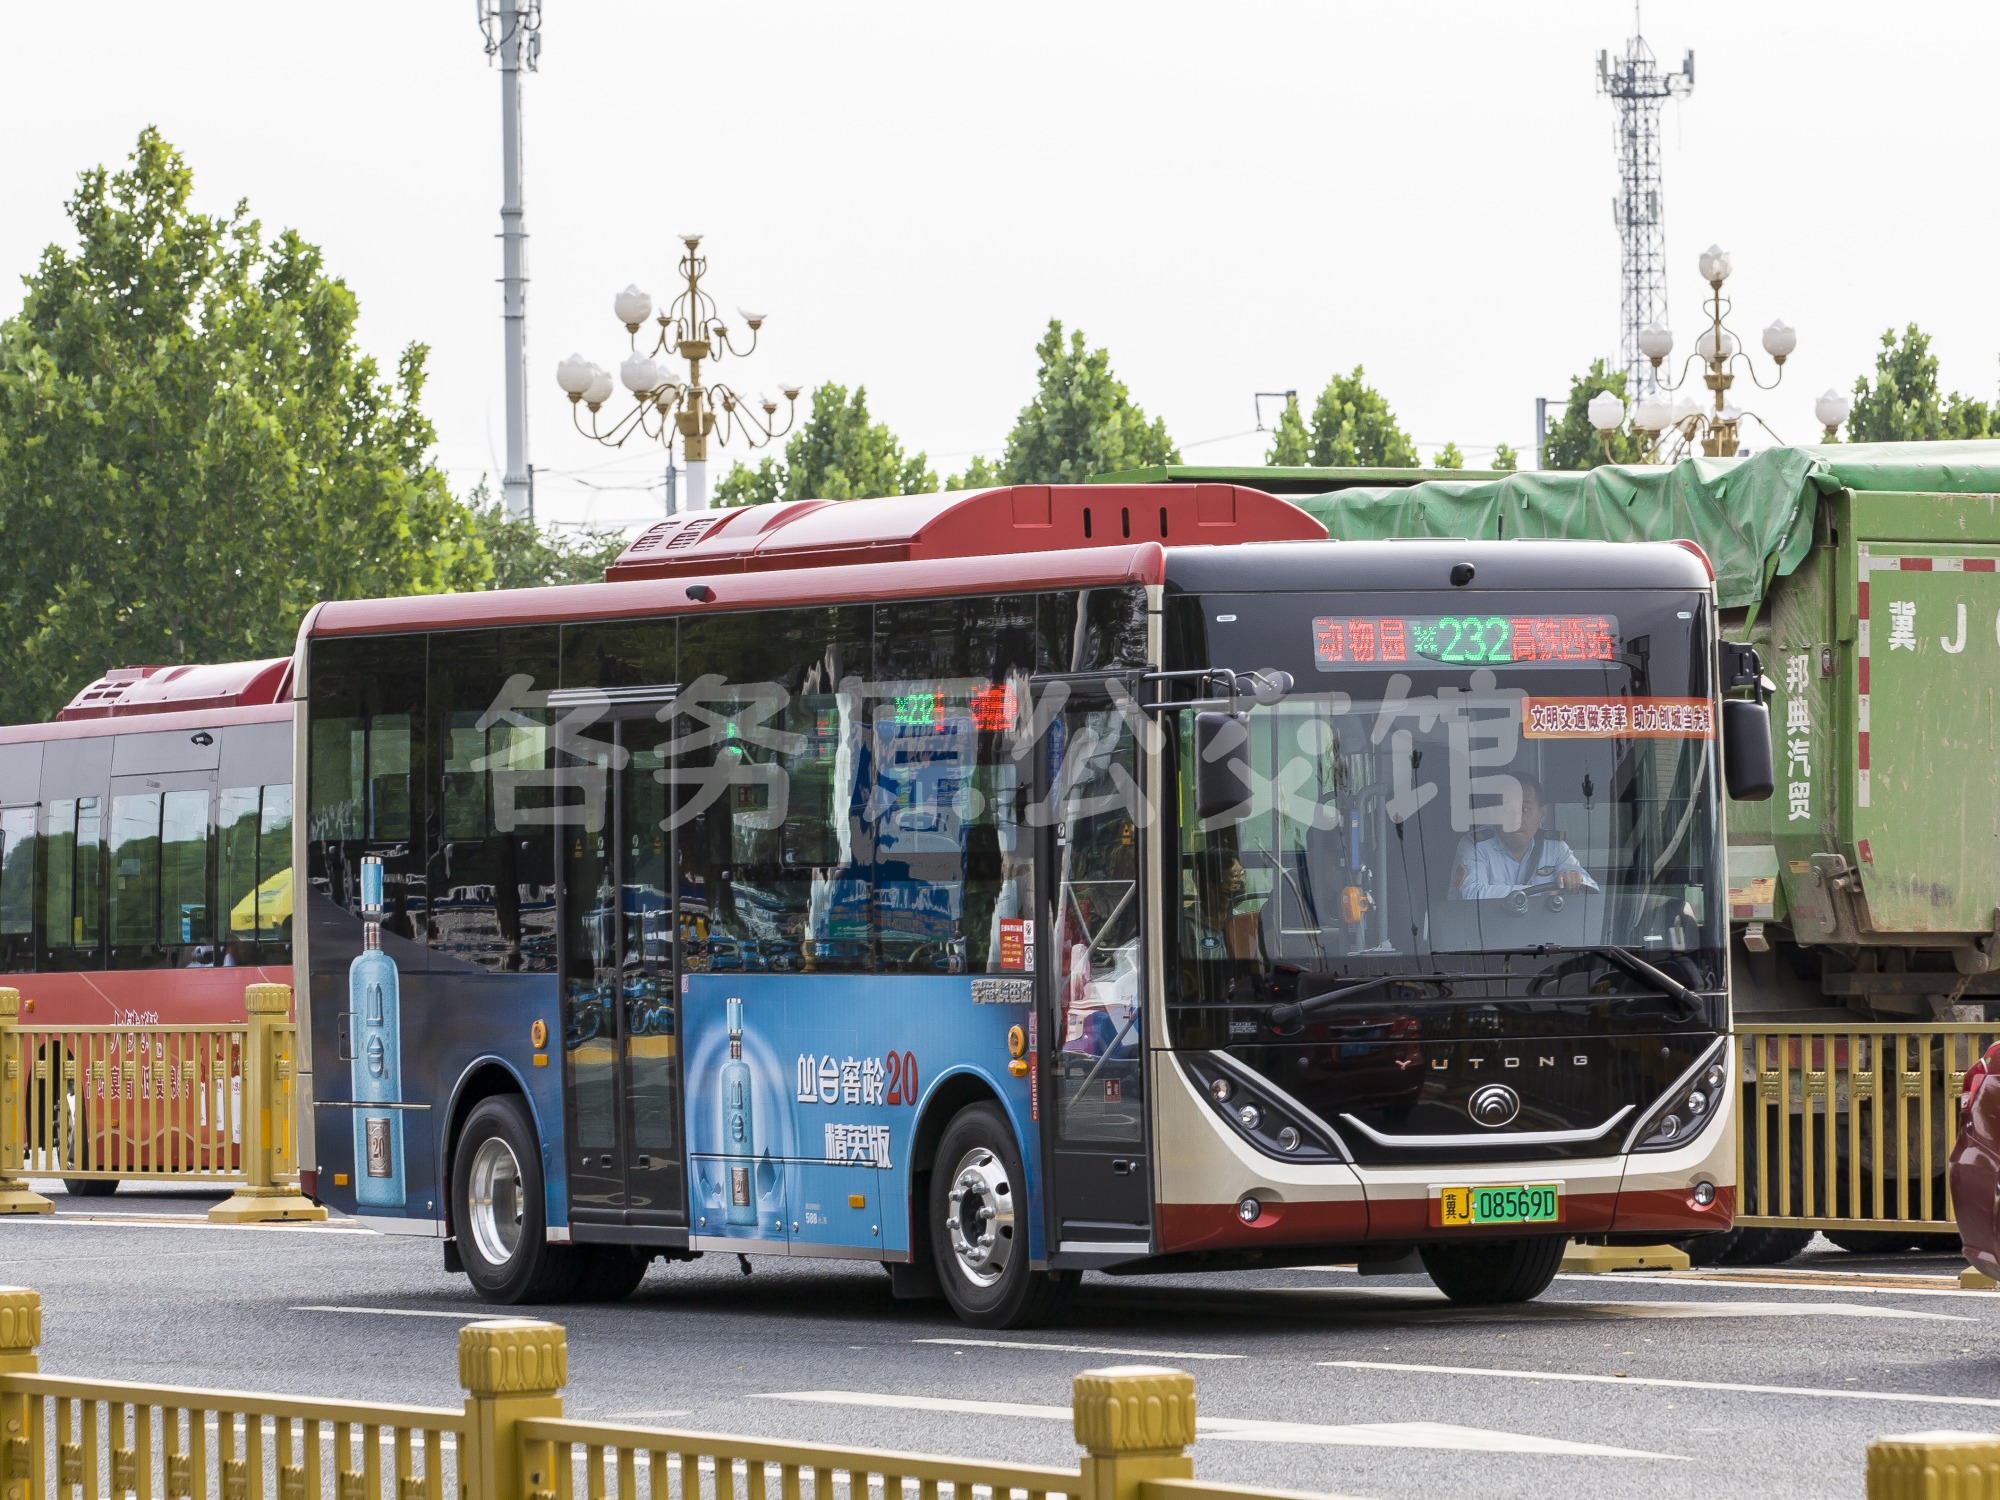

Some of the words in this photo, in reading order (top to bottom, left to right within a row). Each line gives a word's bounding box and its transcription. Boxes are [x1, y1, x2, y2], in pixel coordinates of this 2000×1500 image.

[1315, 616, 1407, 662] 动物园
[1438, 616, 1513, 662] 232
[1511, 615, 1615, 662] 高铁西站
[1530, 703, 1628, 733] 文明交通做表率
[1785, 654, 1811, 821] 邦典汽贸
[1394, 1054, 1590, 1071] YUTONG
[824, 1122, 893, 1169] 精英版
